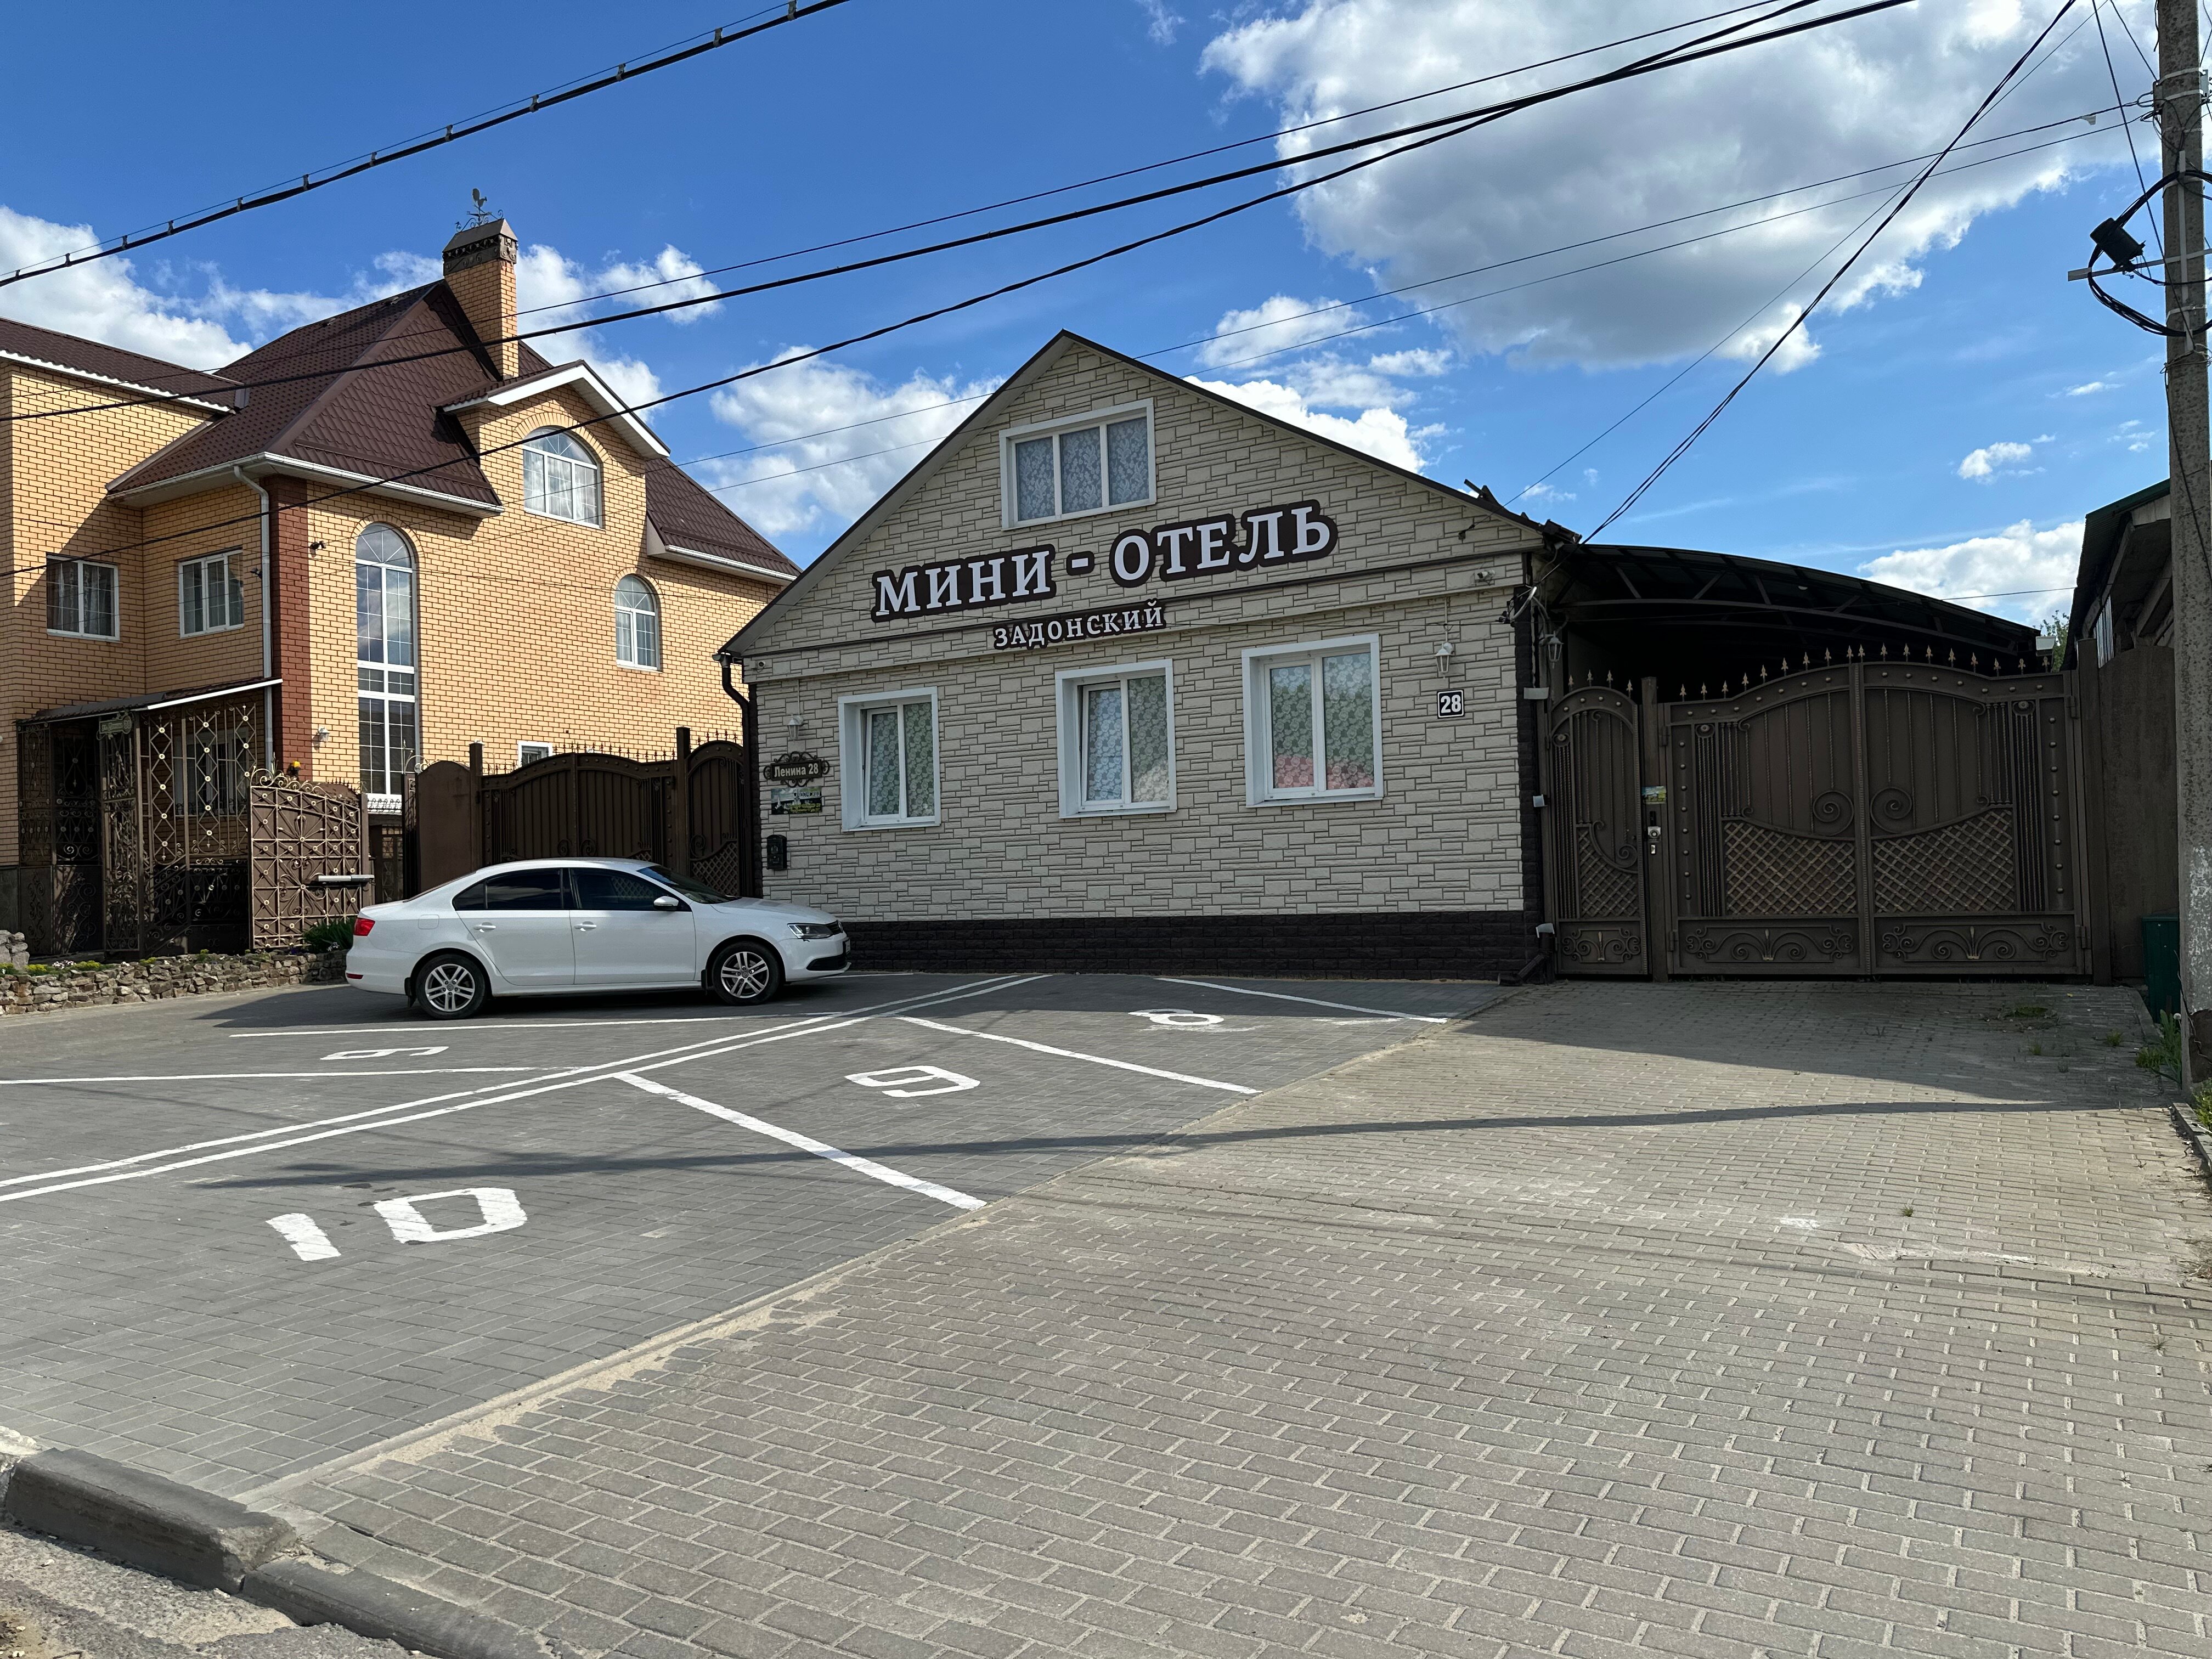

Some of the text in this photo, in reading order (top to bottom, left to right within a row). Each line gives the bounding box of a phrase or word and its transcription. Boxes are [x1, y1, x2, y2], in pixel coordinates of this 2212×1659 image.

[876, 550, 1052, 616] МИНИ
[1115, 506, 1331, 580] ОТЕЛЬ
[995, 600, 1164, 647] ЗАДОНСКИЙ
[1441, 695, 1461, 713] 28
[774, 763, 819, 777] Ленина 28
[1128, 1008, 1224, 1025] 8
[844, 1065, 980, 1097] 9
[266, 1188, 527, 1261] 10
